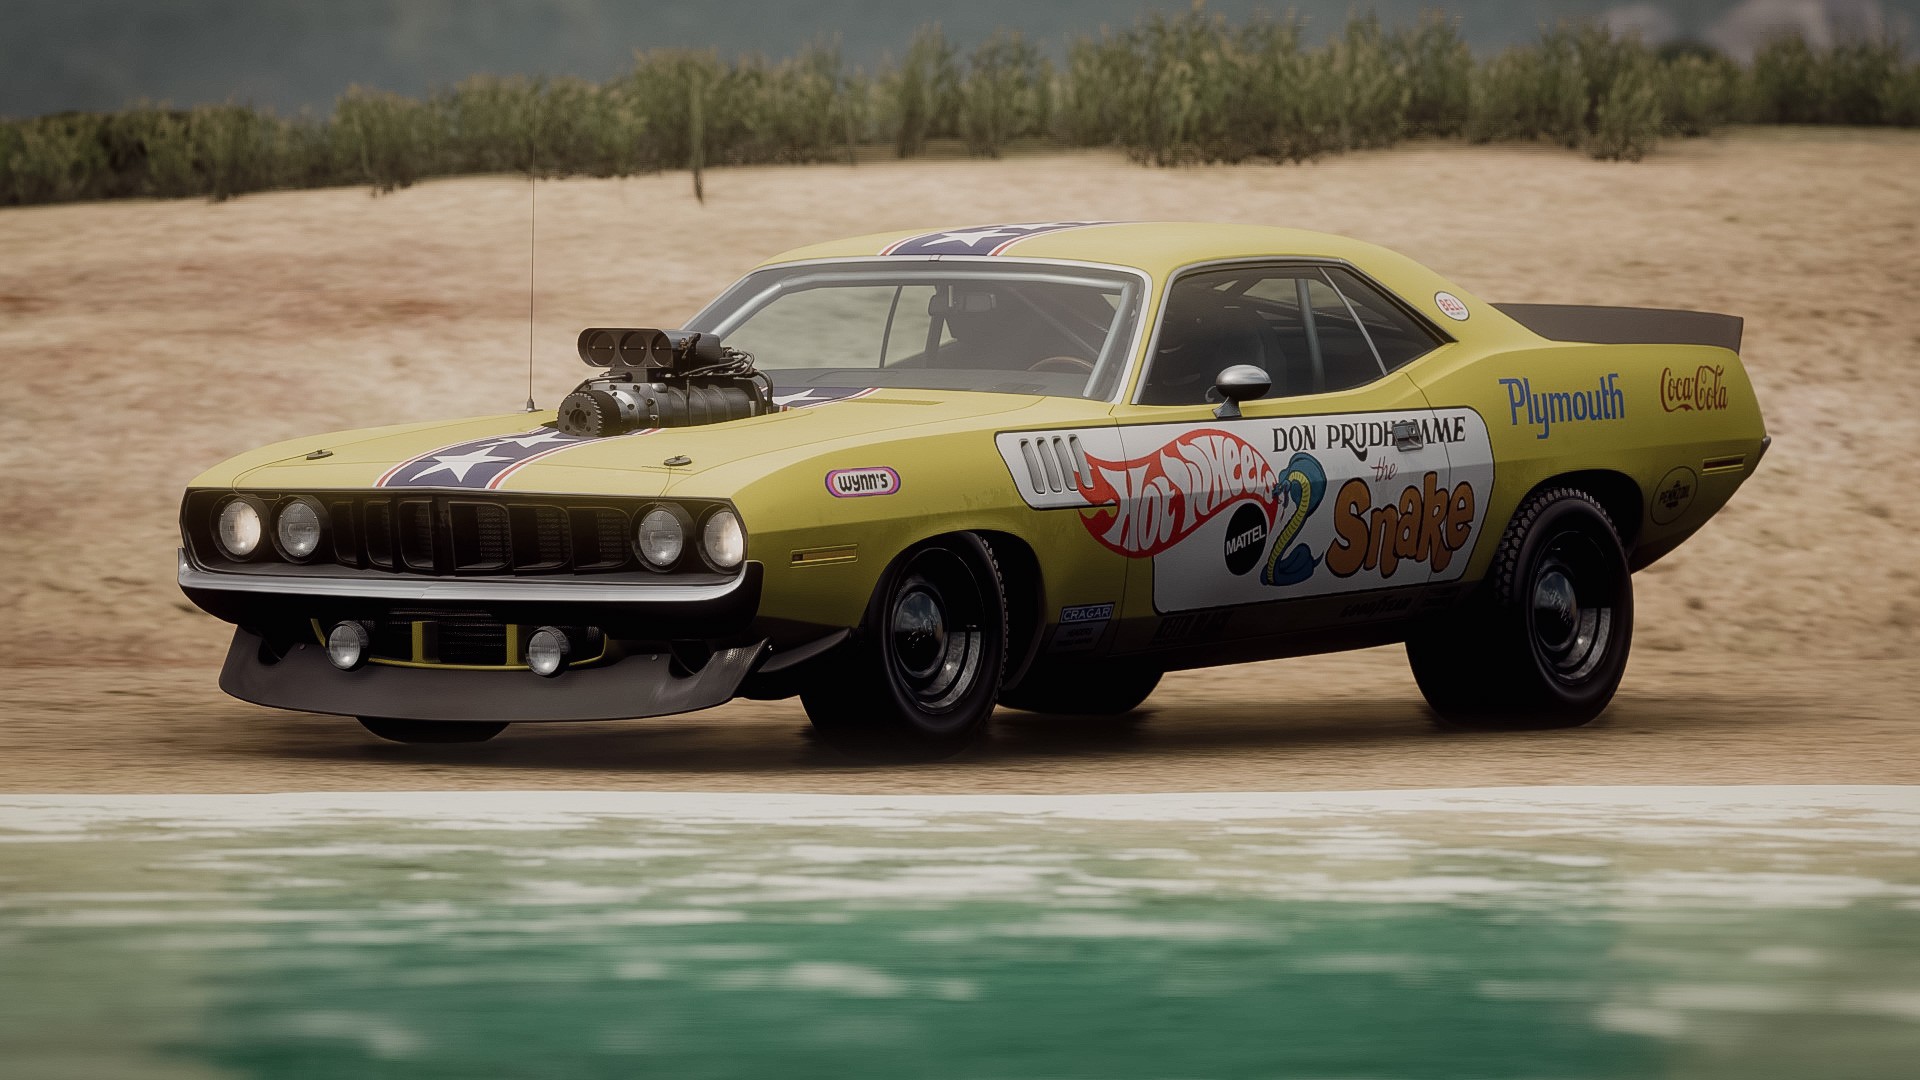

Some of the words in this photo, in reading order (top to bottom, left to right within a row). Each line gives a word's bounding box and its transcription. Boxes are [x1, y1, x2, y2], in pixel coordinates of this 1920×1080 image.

[1438, 298, 1464, 311] BELL
[1498, 373, 1625, 440] Plymouth
[1660, 365, 1729, 413] Coca-Cola
[1272, 424, 1317, 453] DON
[1326, 416, 1467, 462] PRUDHMME
[1370, 456, 1399, 483] the
[1226, 524, 1266, 557] MATTEL
[1325, 470, 1475, 579] Snake
[1063, 606, 1111, 621] CRAGAR
